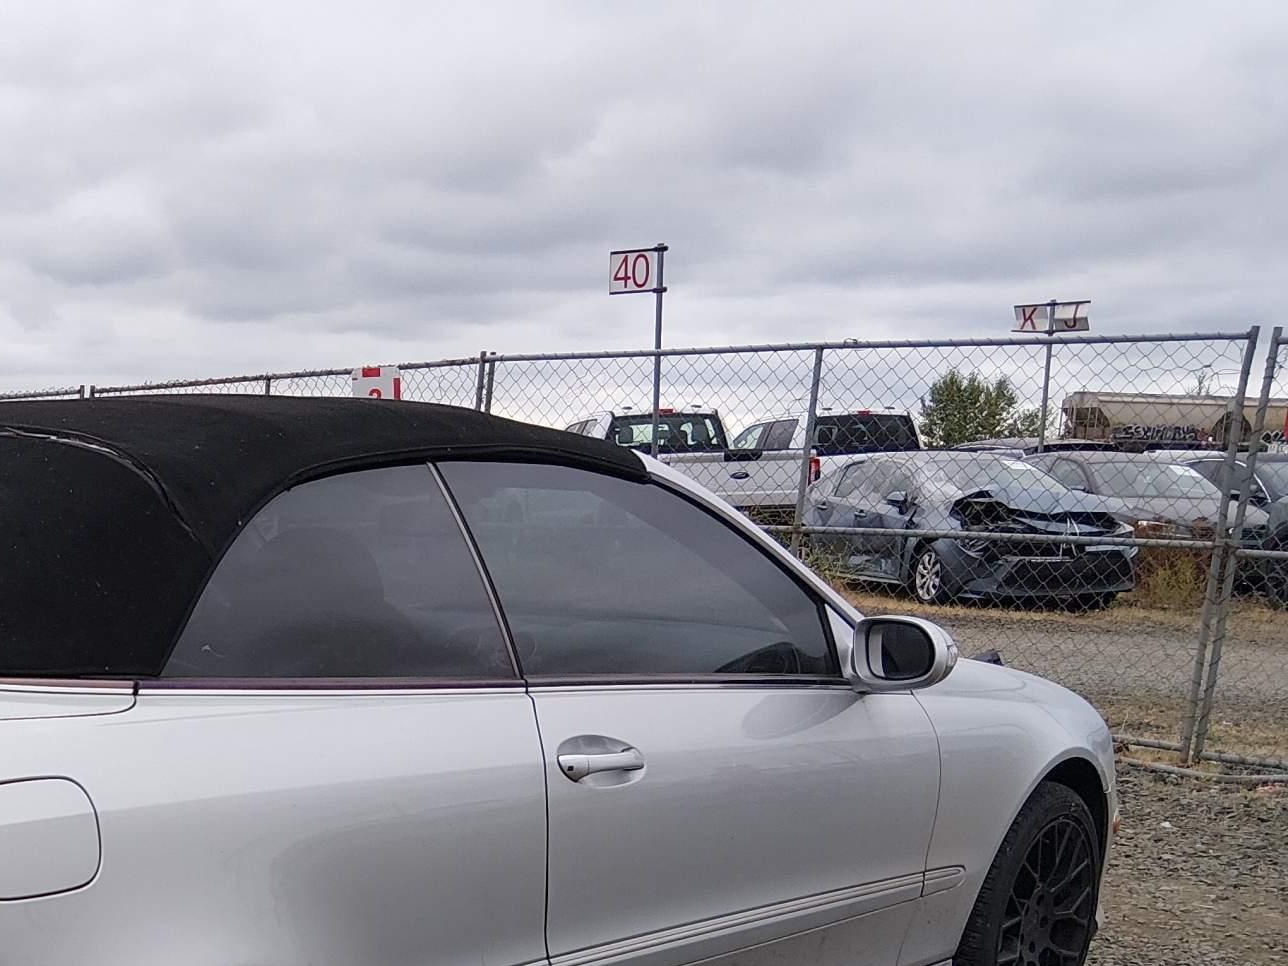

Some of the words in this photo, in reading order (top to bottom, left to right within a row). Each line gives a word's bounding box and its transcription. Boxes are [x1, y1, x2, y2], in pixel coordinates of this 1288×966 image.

[613, 253, 650, 289] 40
[1020, 307, 1038, 330] K
[1064, 304, 1080, 329] J
